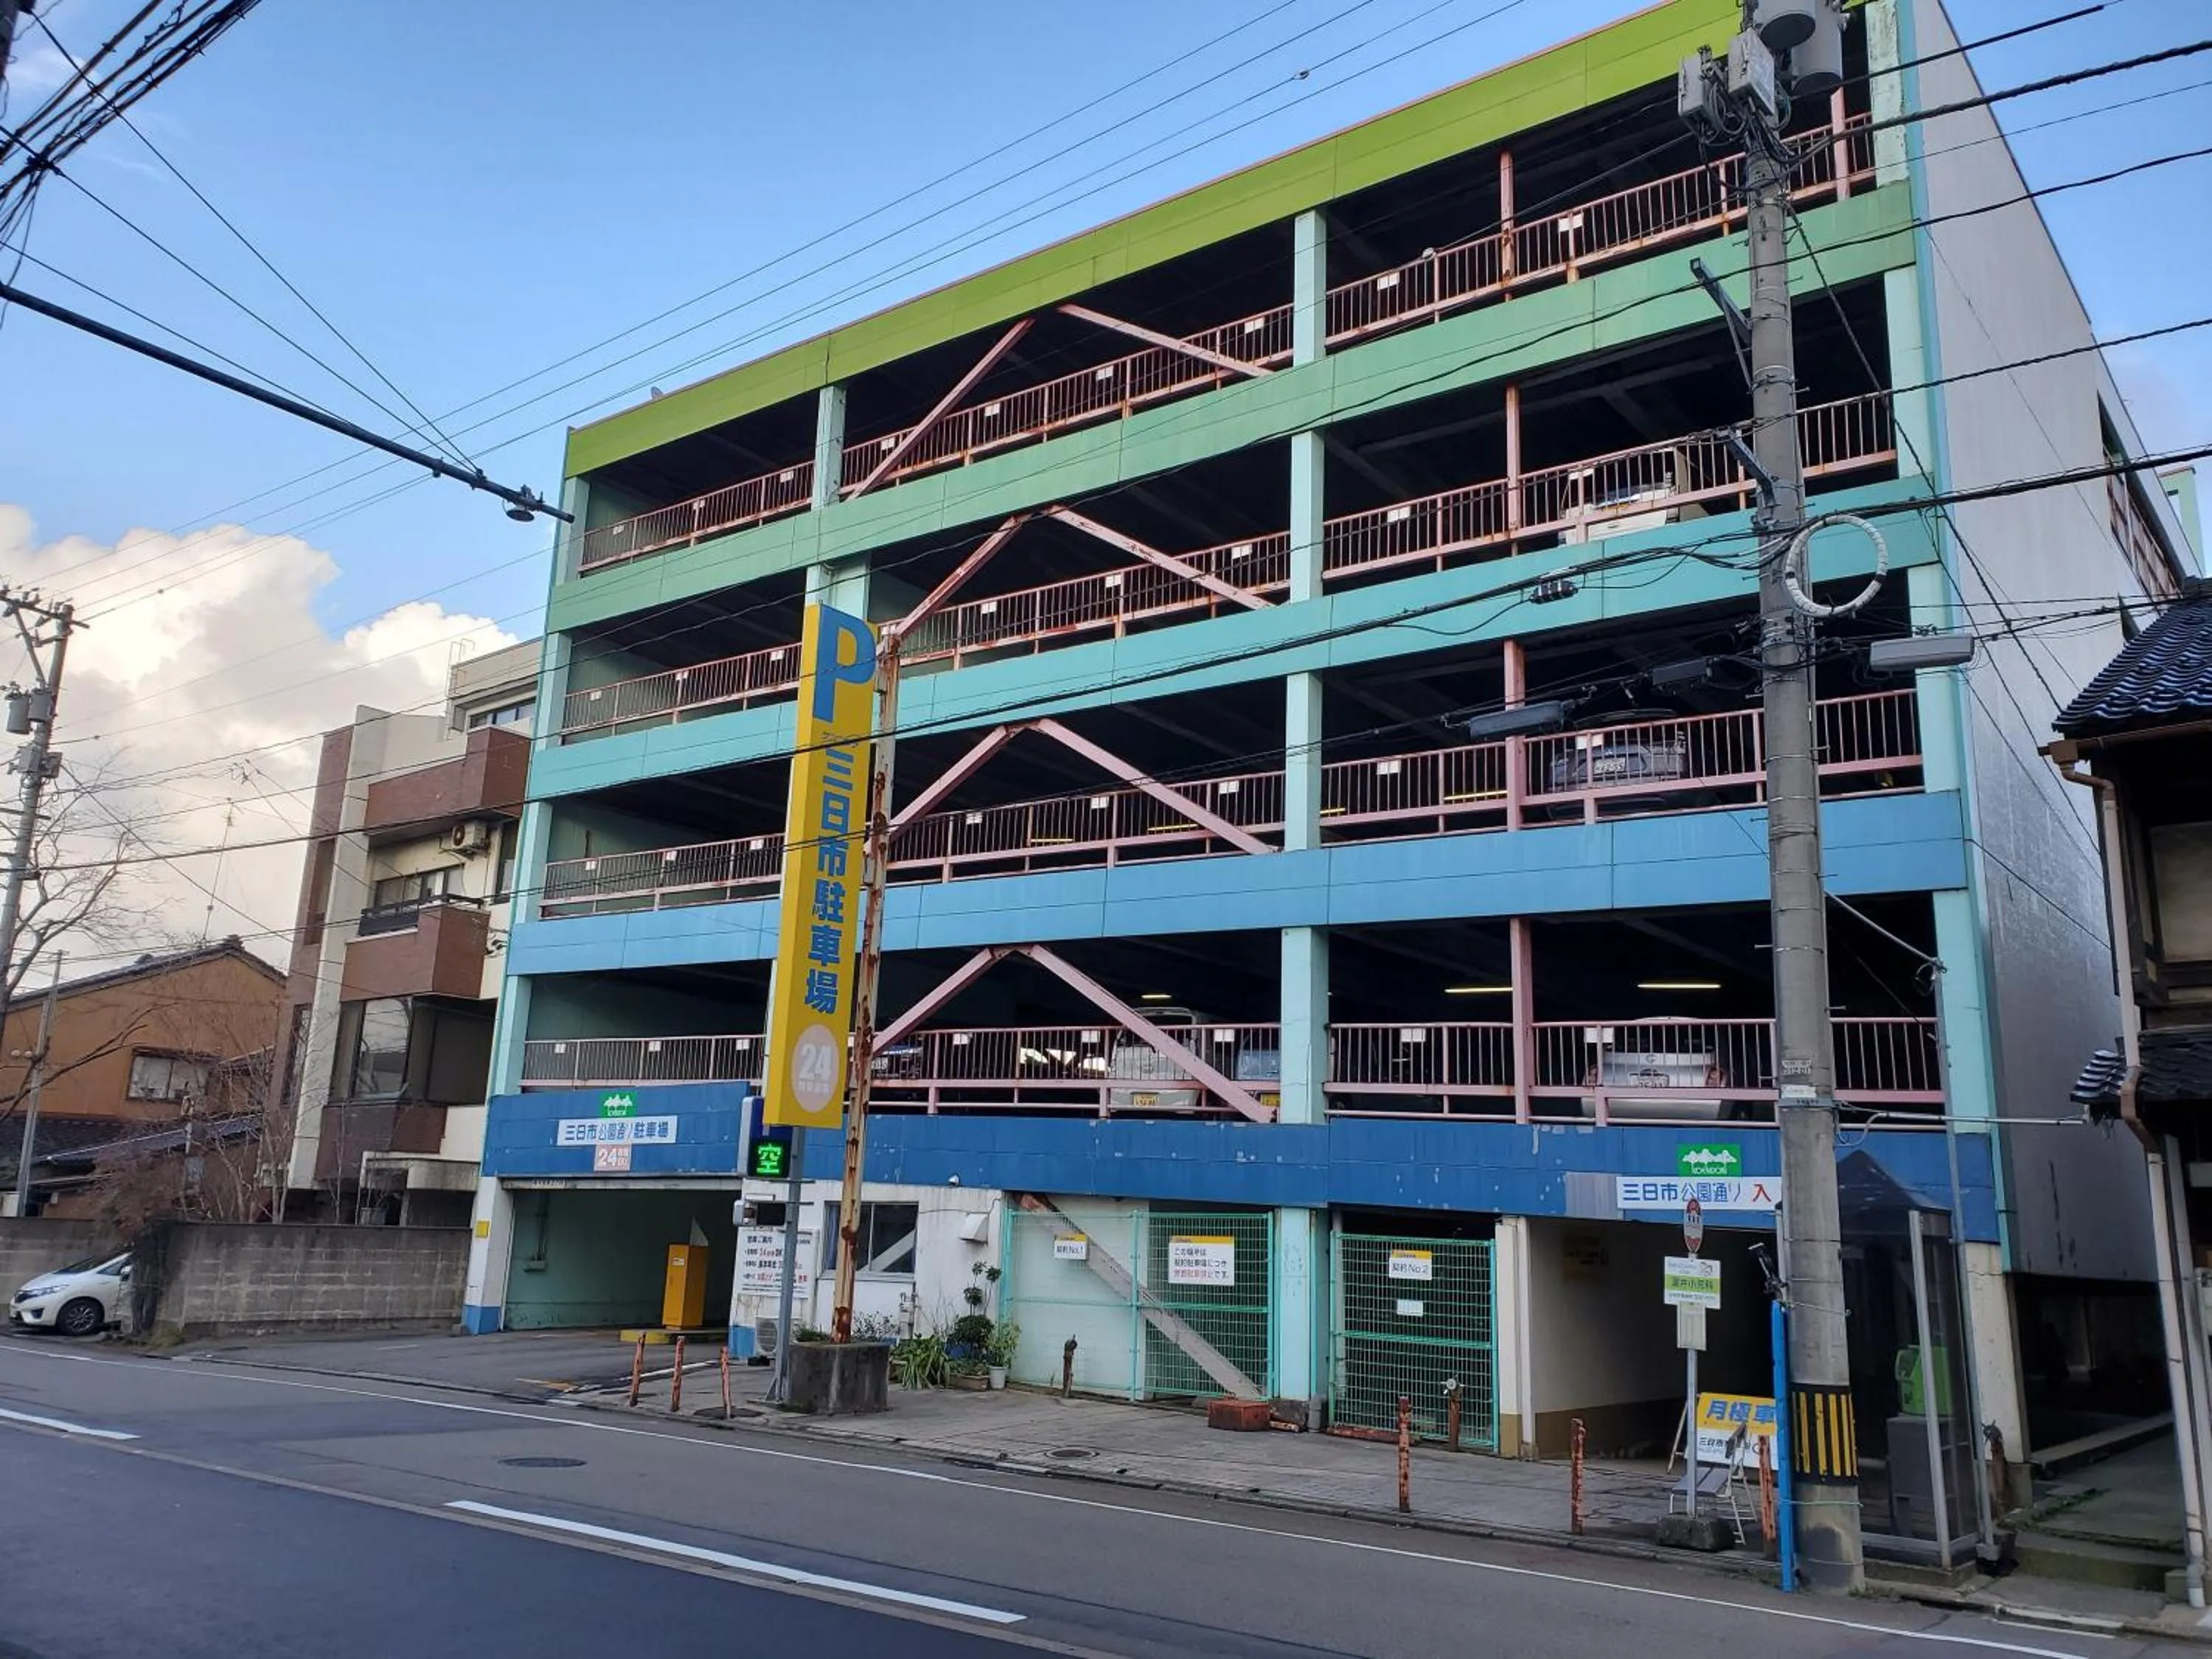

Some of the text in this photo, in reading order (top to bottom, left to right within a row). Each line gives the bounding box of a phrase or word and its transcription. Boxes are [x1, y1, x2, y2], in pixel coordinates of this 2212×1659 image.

[813, 605, 876, 723] P
[804, 748, 854, 1015] 三日市駐車場
[799, 1043, 832, 1080] 24
[565, 1120, 669, 1141] 三日市公園通り駐車場
[598, 1148, 617, 1167] 24
[757, 1143, 783, 1174] 空
[1623, 1181, 1771, 1203] 三日市公園通り 入
